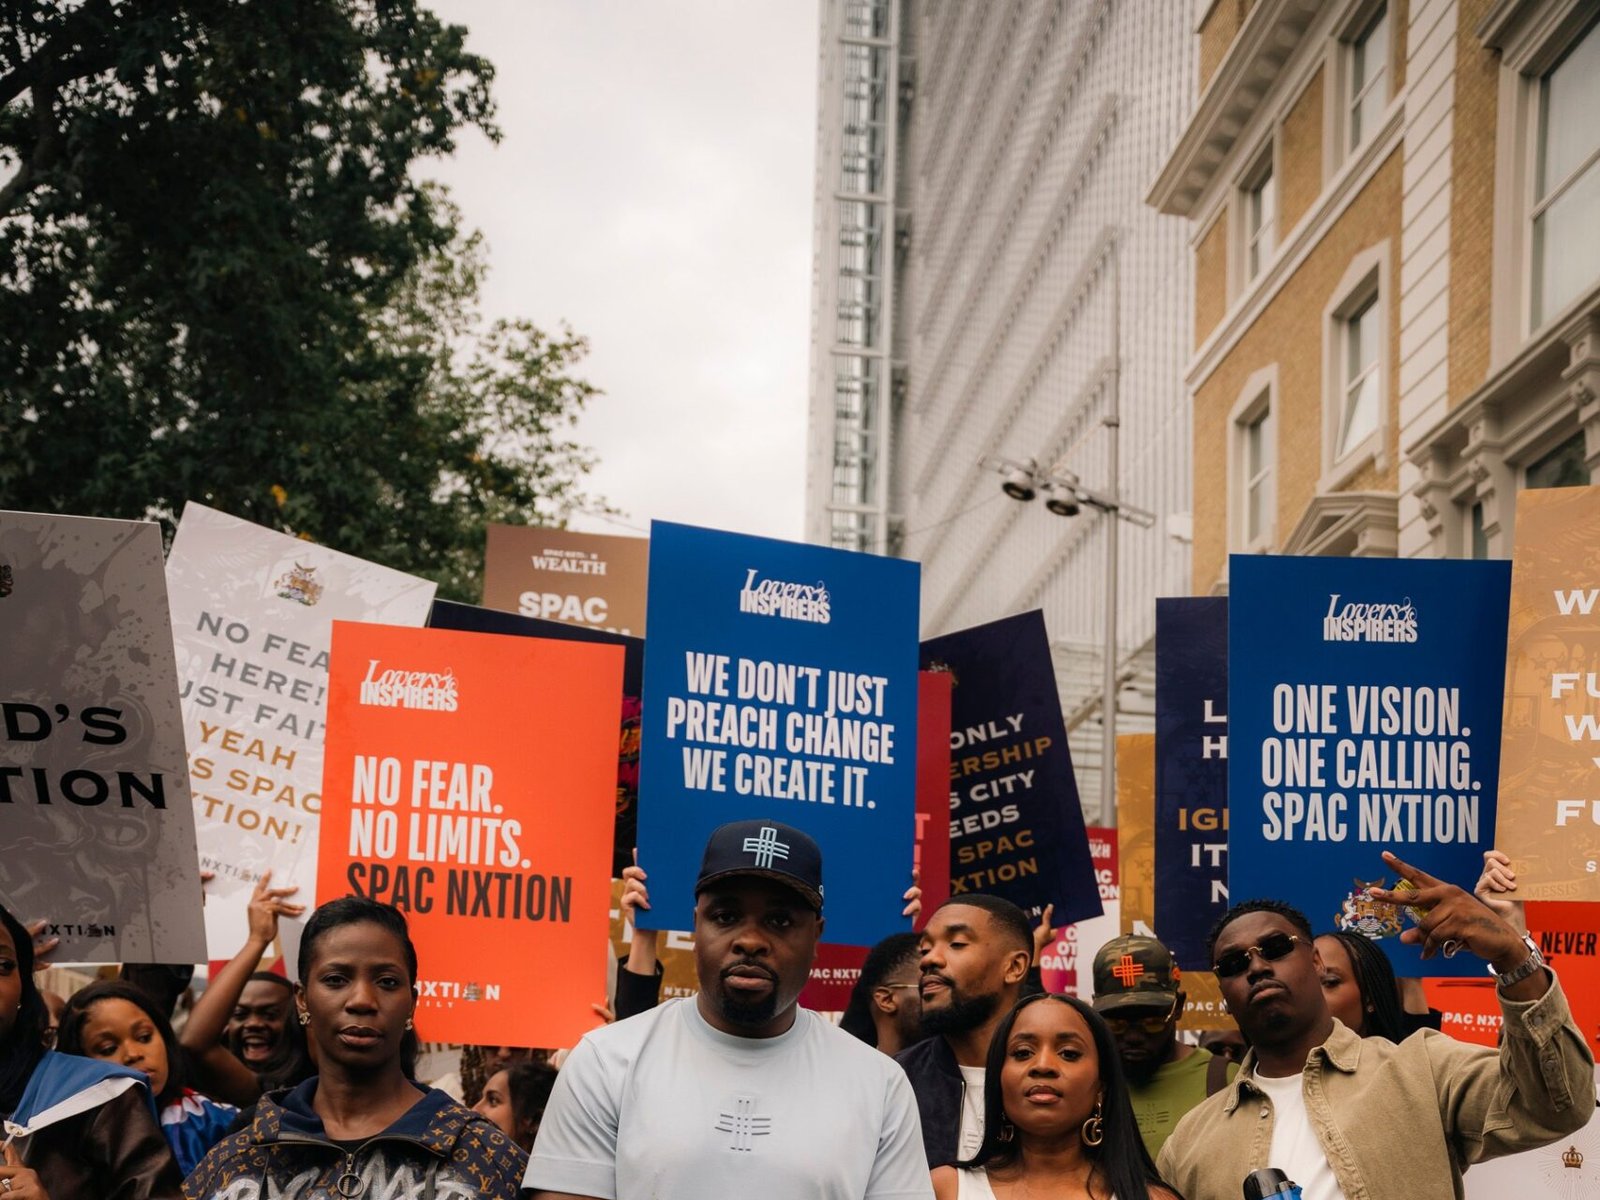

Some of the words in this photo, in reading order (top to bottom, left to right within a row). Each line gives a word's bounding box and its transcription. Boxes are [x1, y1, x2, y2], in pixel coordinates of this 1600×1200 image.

[532, 556, 606, 575] WEALTH
[197, 611, 249, 644] NO
[518, 591, 609, 624] SPAC
[740, 590, 830, 624] INSPIRERS
[1324, 617, 1418, 643] INSPIRERS
[210, 653, 325, 706] HERE!
[360, 681, 459, 712] INSPIRERS
[685, 651, 730, 697] WE
[825, 671, 888, 718] JUST
[667, 697, 777, 750] PREACH
[785, 711, 895, 764] CHANGE
[1273, 683, 1337, 733] ONE
[1347, 685, 1471, 737] VISION.
[200, 722, 296, 770] YEAH
[1261, 737, 1325, 789] ONE
[1336, 739, 1482, 791] CALLING.
[352, 755, 401, 806] NO
[411, 760, 503, 814] FEAR.
[682, 747, 727, 793] WE
[734, 752, 835, 804] CREATE
[843, 766, 876, 809] IT.
[970, 769, 1035, 802] CITY
[191, 792, 302, 844] TION!
[349, 808, 398, 859] NO
[408, 812, 531, 868] LIMITS.
[1261, 791, 1348, 842] SPAC
[1359, 793, 1479, 844] NXTION
[958, 830, 1034, 863] SPAC
[346, 862, 434, 914] SPAC
[446, 868, 572, 922] NXTION
[1541, 931, 1596, 956] NEVER
[1183, 1001, 1214, 1011] PAC
[1442, 1012, 1473, 1024] PAC
